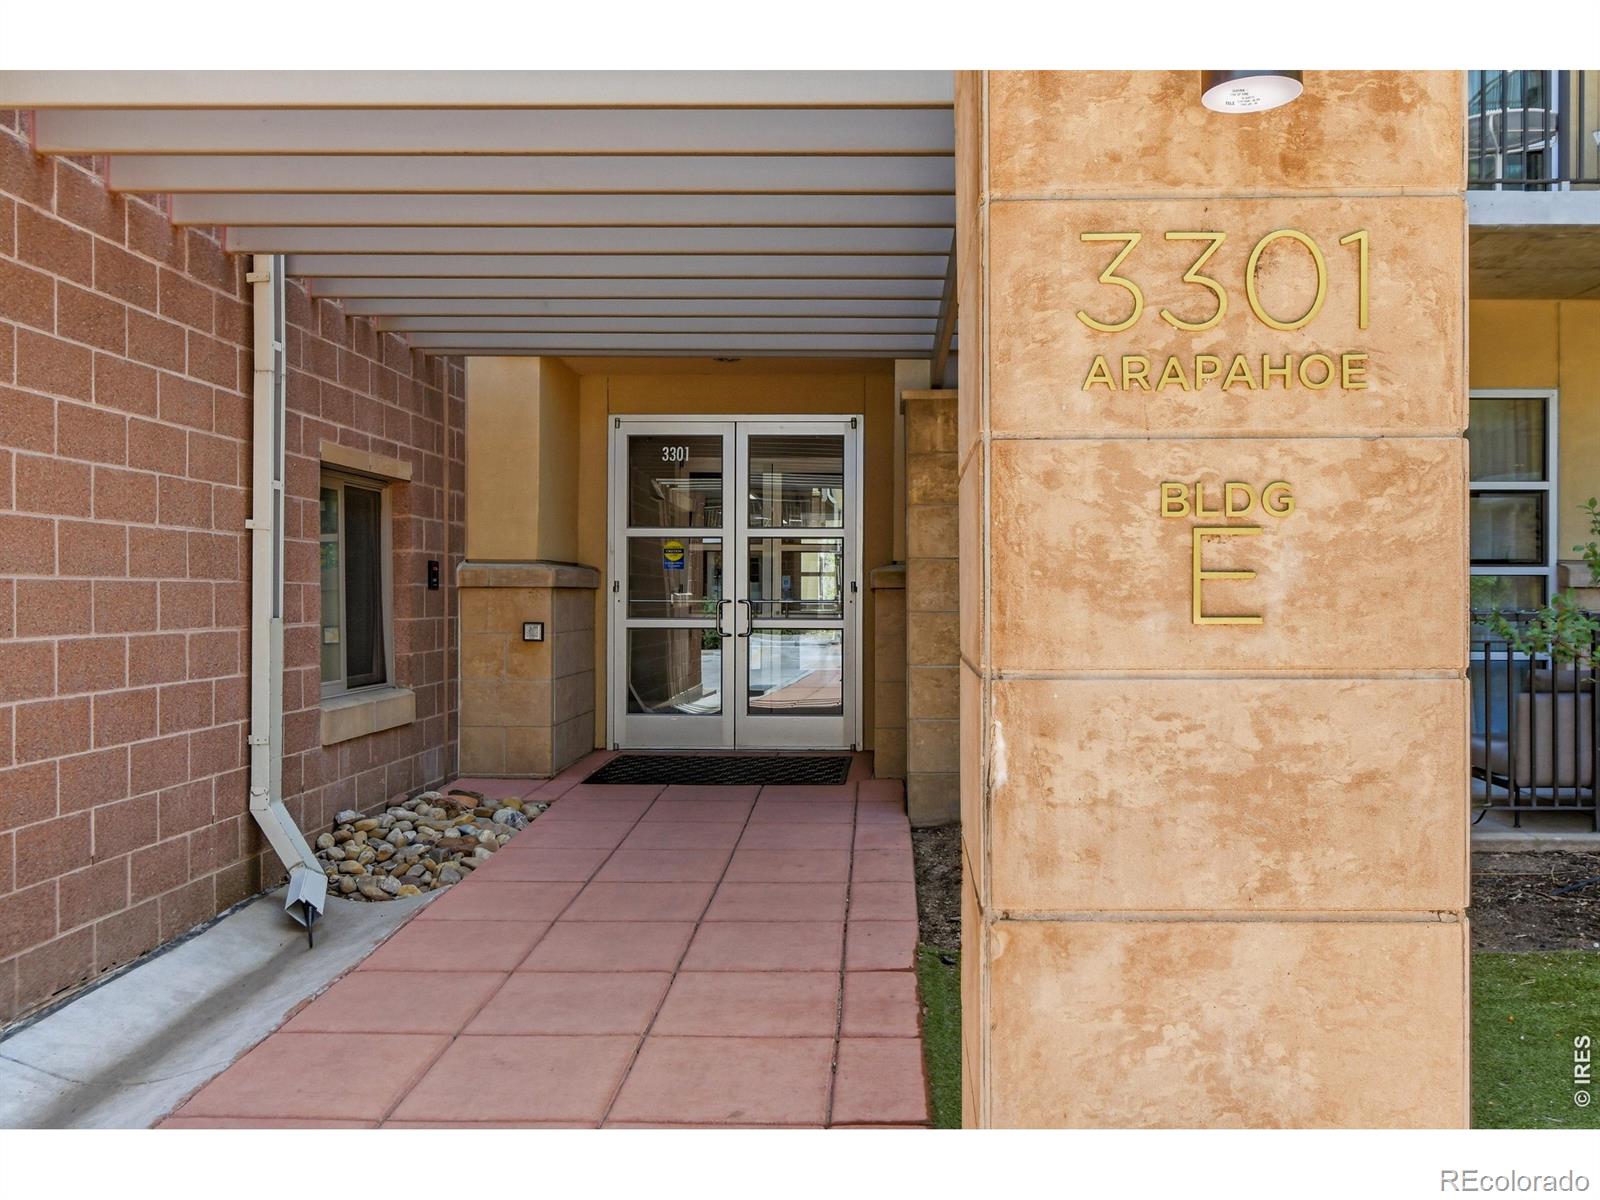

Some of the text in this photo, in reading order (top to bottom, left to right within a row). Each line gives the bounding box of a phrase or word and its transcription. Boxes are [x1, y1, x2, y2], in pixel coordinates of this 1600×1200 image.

[1076, 228, 1370, 332] 3301
[1082, 353, 1369, 392] ARAPAHOE
[662, 446, 689, 462] 3301
[1160, 481, 1297, 518] BLDG
[1192, 526, 1265, 625] E
